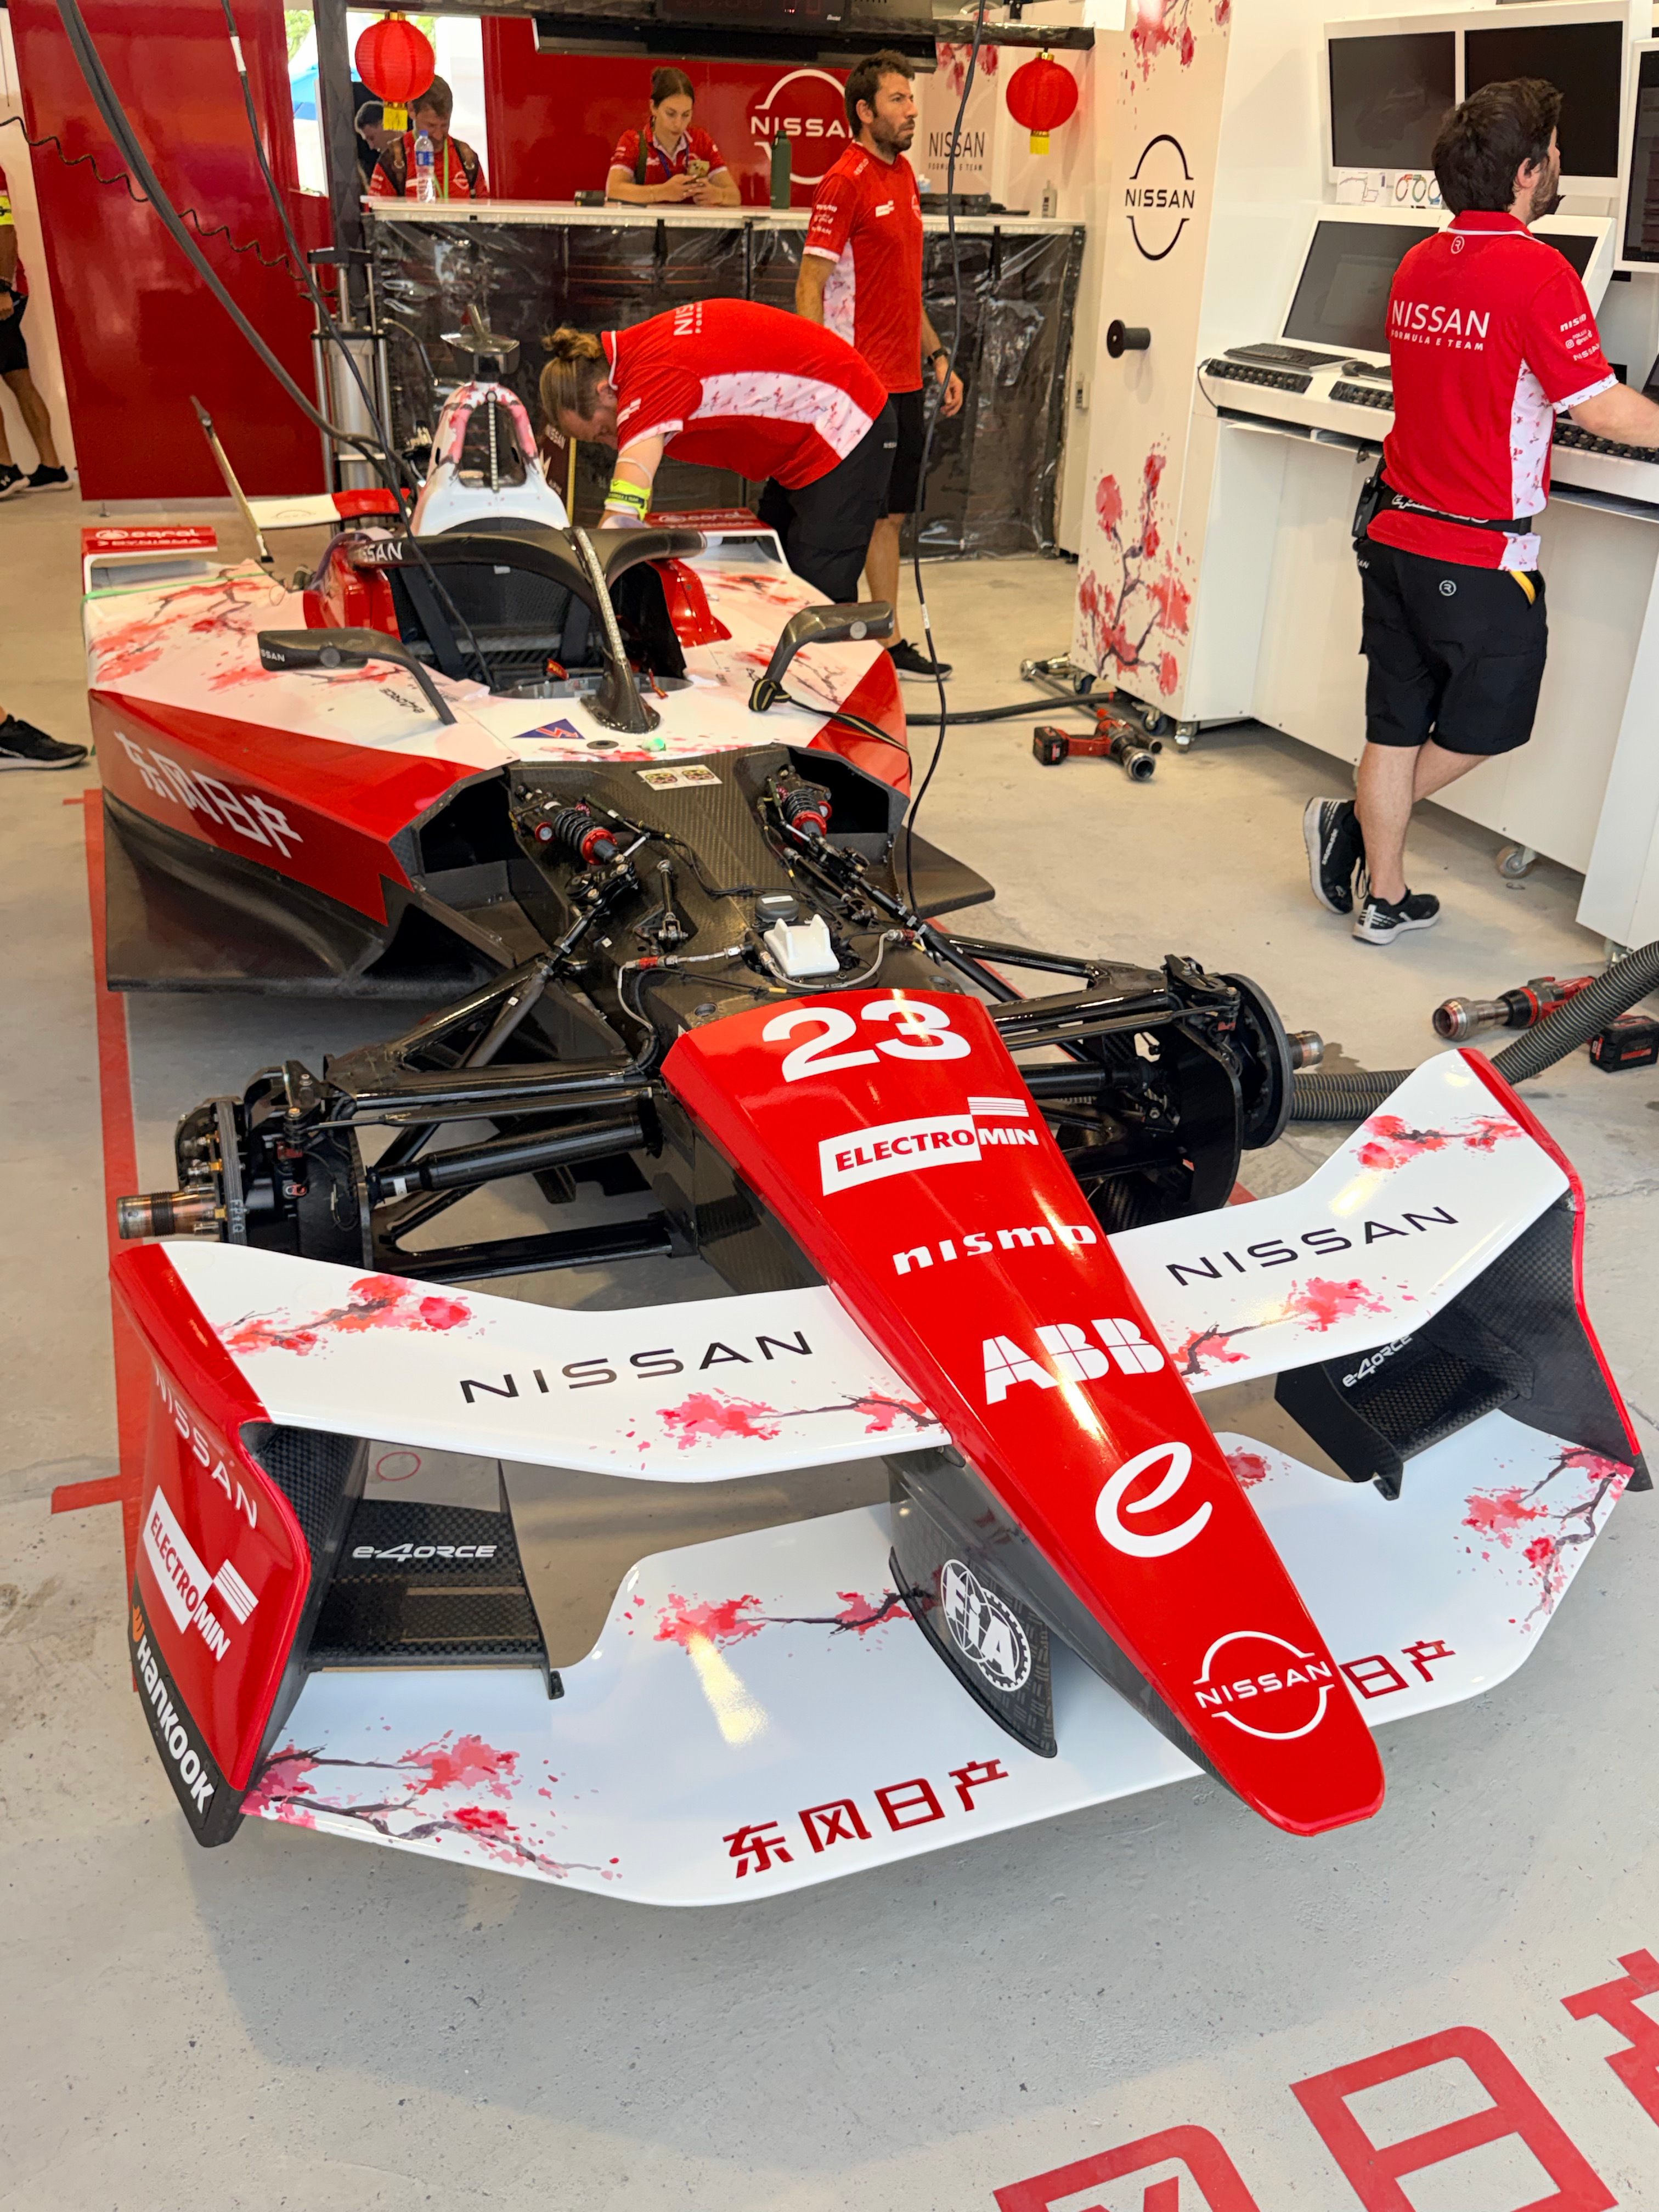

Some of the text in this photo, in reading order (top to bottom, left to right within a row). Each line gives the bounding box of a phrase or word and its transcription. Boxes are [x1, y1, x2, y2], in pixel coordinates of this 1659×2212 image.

[751, 116, 853, 138] NISSA
[929, 132, 985, 157] NISSAN
[1125, 189, 1195, 208] NISSAN
[1391, 330, 1431, 345] FORMULA
[1448, 339, 1483, 351] TEAM
[1392, 300, 1490, 338] NISSAN
[762, 1000, 971, 1082] 23
[836, 1128, 1039, 1172] ELECTROMIN
[893, 1225, 1097, 1275] nismo
[1166, 1206, 1459, 1286] NISSAN
[460, 1331, 812, 1403] NISSAN
[983, 1318, 1165, 1404] ABB
[156, 1364, 257, 1529] NISSAN
[150, 1510, 231, 1662] ELECTROMIN
[1194, 1661, 1332, 1708] NISSAN
[723, 1758, 1009, 1878] 东风日产
